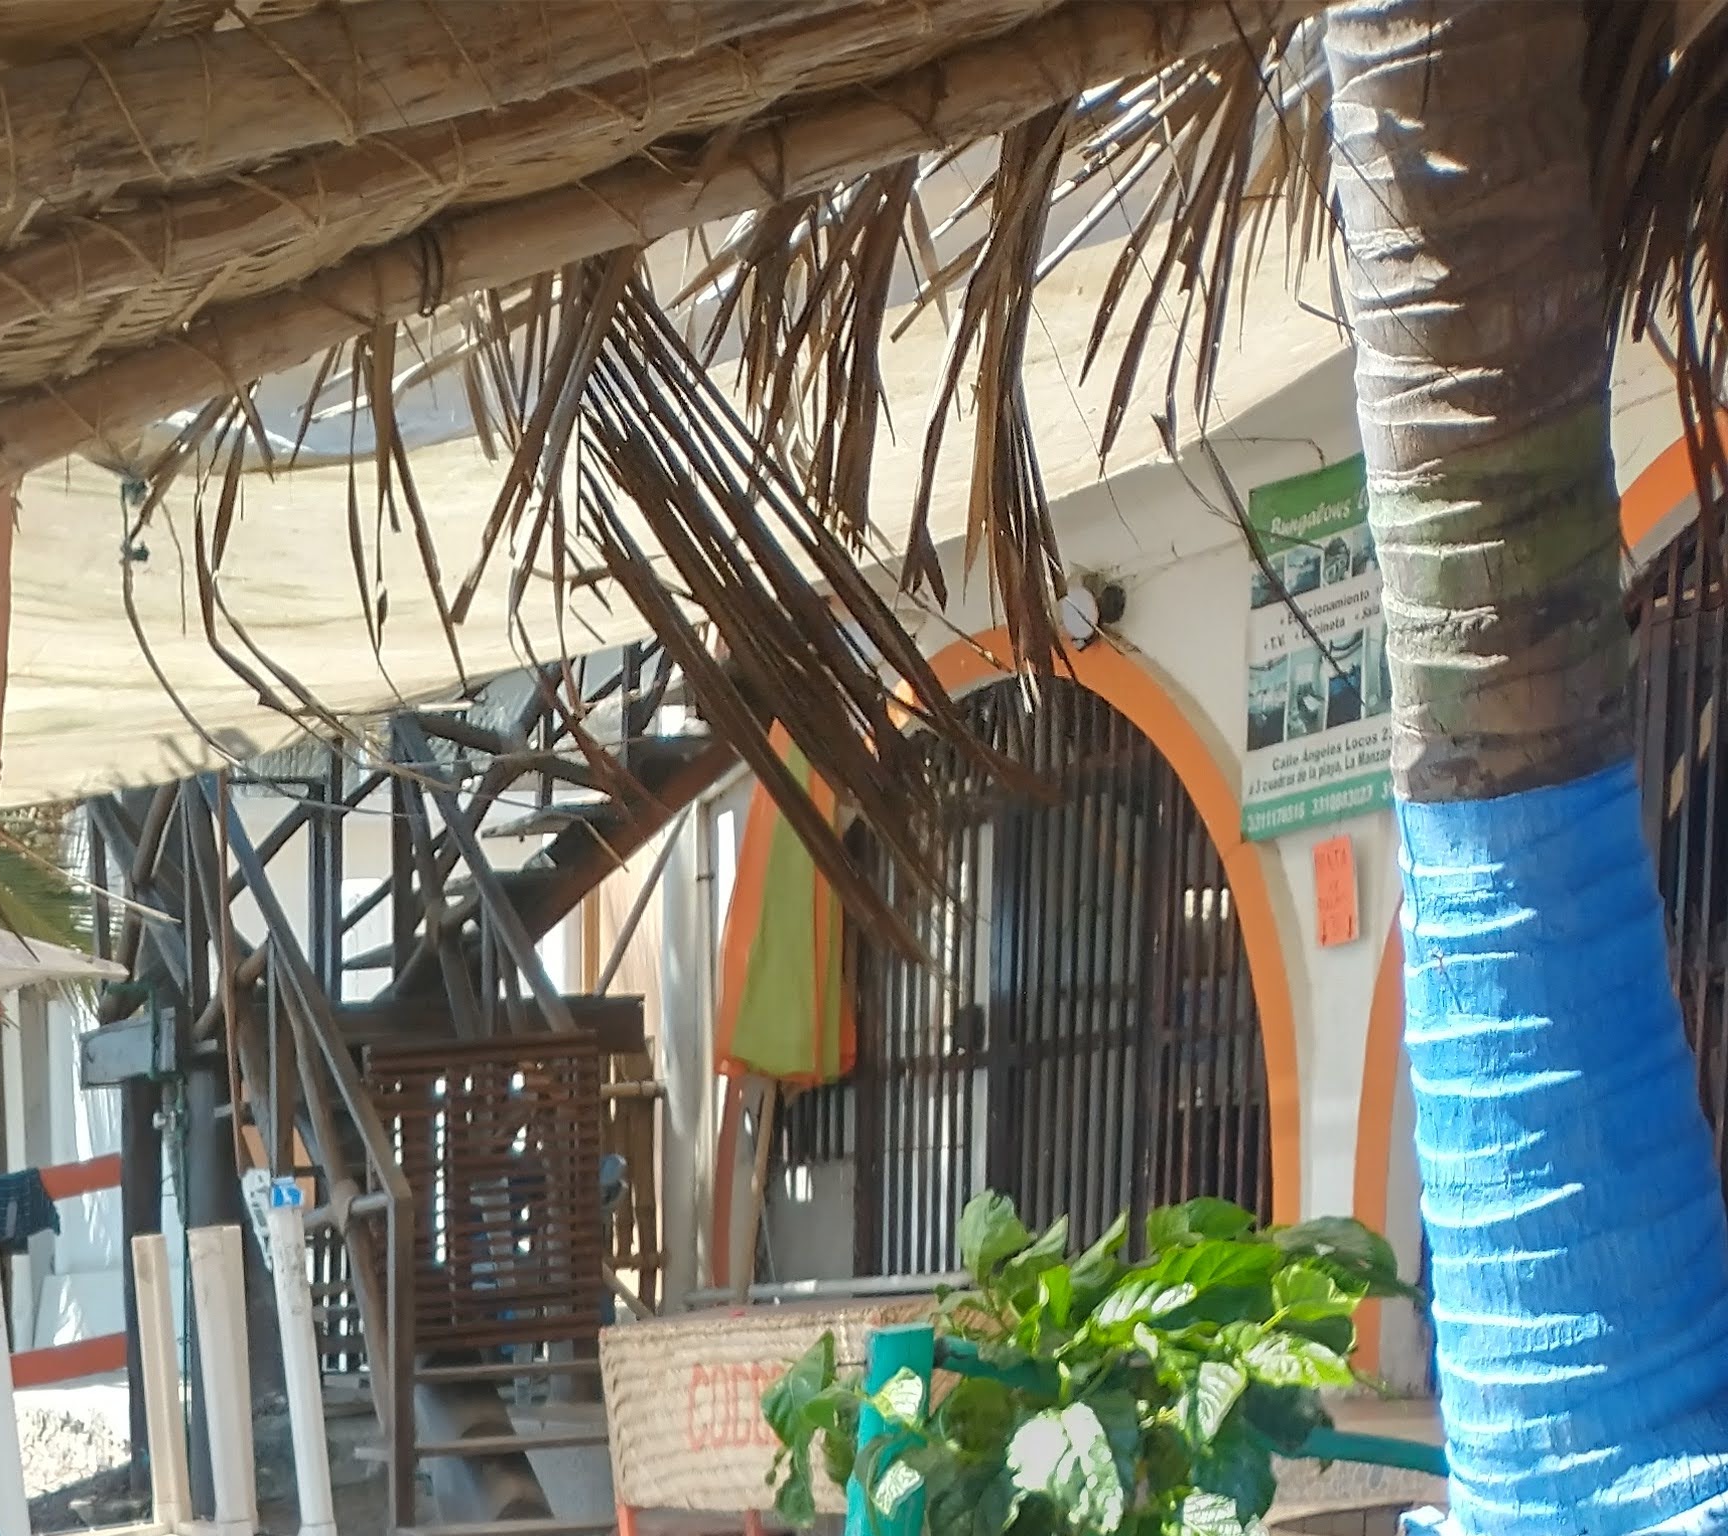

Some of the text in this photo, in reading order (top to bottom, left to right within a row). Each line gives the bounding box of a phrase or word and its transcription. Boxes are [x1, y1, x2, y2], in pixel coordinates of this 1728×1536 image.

[1302, 616, 1345, 639] Ccineta
[1272, 756, 1300, 771] Calle
[1345, 733, 1378, 751] Locos
[1345, 755, 1355, 770] La
